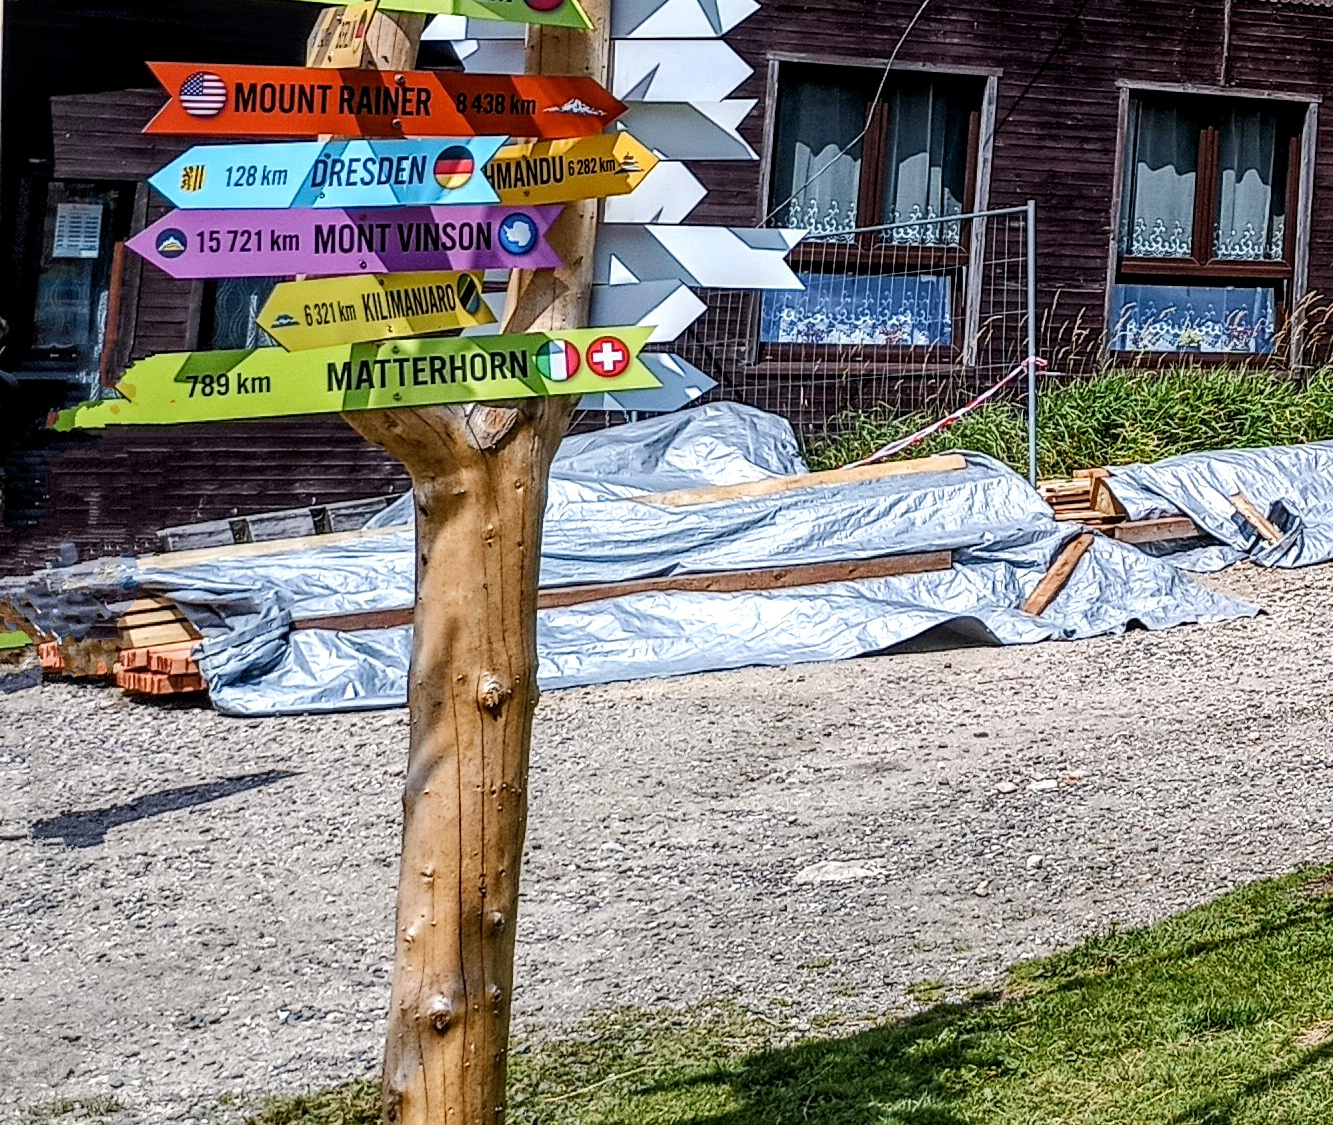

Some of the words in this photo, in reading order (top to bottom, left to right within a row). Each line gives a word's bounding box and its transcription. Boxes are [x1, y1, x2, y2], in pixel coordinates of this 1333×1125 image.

[233, 82, 333, 114] MOUNT
[338, 83, 432, 117] RAINER
[509, 92, 537, 117] km
[224, 165, 257, 188] 128
[261, 164, 289, 187] km
[310, 155, 428, 189] DRESDEN
[599, 156, 616, 174] km
[269, 229, 300, 252] km
[314, 223, 392, 255] MONT
[400, 221, 493, 253] VINSON
[338, 300, 358, 323] km
[361, 283, 457, 323] KILIMANJARO
[186, 372, 230, 399] 789
[236, 372, 272, 396] km
[326, 348, 529, 393] MATTERHORN
